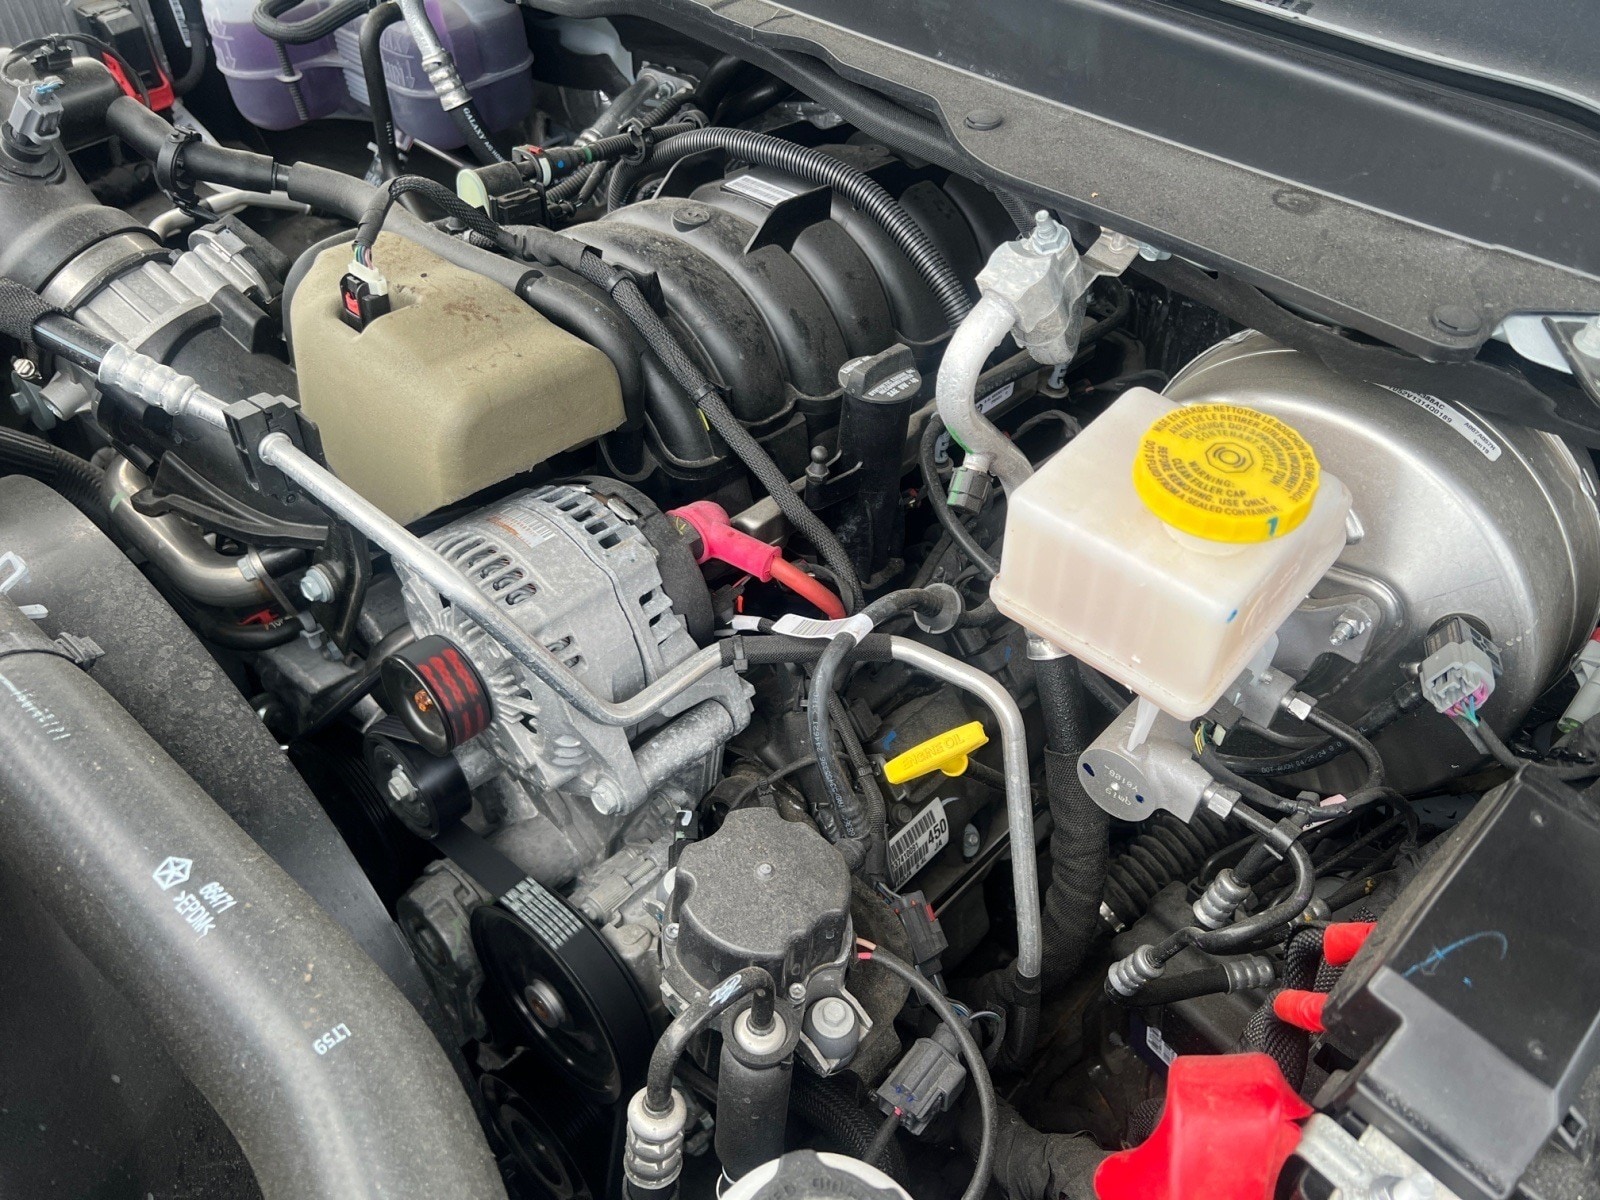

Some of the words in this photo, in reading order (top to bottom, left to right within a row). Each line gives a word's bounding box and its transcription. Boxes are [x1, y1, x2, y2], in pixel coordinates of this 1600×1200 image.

[463, 107, 487, 139] GALAXY
[1167, 411, 1179, 422] EN
[1213, 405, 1261, 420] NETTOYER
[1262, 416, 1275, 425] LE
[1191, 414, 1204, 423] DE
[1205, 413, 1218, 421] LE
[1228, 422, 1249, 432] DOT
[1172, 458, 1193, 480] CLEAN
[1190, 477, 1223, 495] FILLER
[1226, 489, 1247, 498] CAP
[1185, 497, 1223, 514] SEALED
[1219, 497, 1240, 508] USE
[1243, 496, 1270, 507] ONLY
[902, 744, 945, 770] ENGINE
[944, 734, 965, 750] OIL
[927, 818, 947, 845] 450
[313, 1022, 352, 1055] LT59
